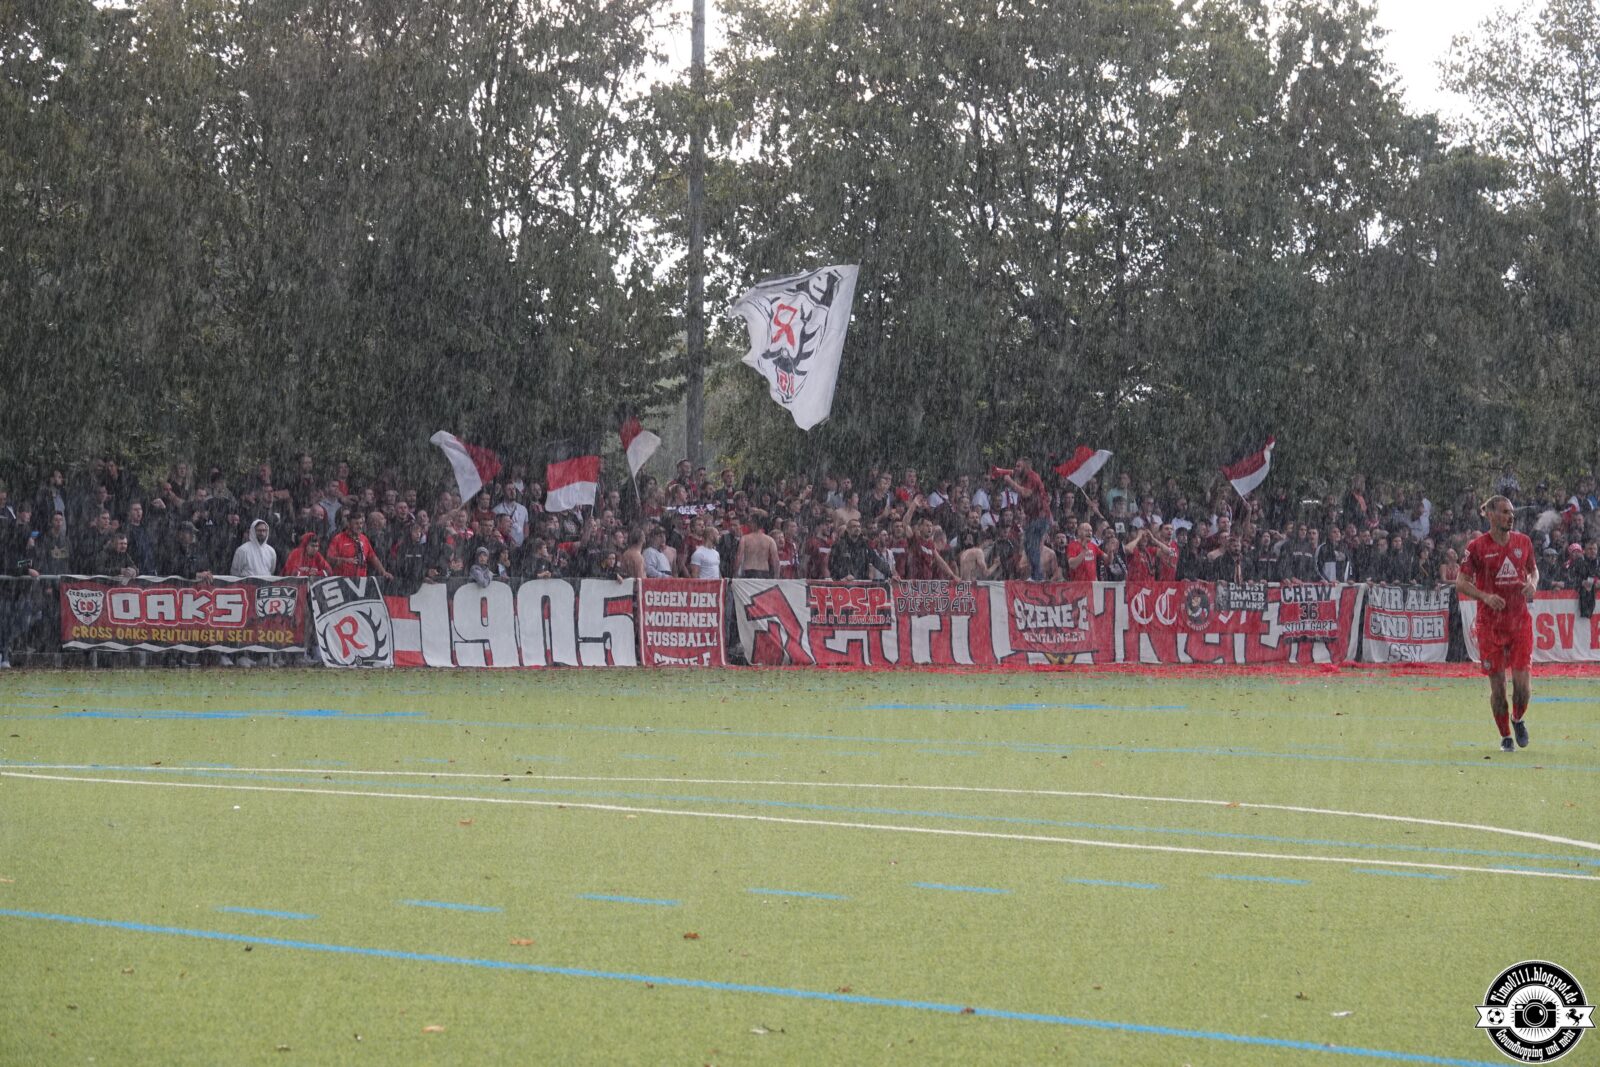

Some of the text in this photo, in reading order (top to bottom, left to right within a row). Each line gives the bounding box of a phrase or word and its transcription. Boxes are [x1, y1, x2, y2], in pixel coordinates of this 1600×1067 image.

[259, 587, 296, 598] SSV
[644, 590, 717, 608] GEGEN DEN
[810, 586, 887, 616] TPSP
[1230, 591, 1265, 602] IMMER
[1282, 584, 1332, 602] CREW
[1368, 586, 1450, 611] WIR ALLE
[108, 590, 247, 624] OAKS
[269, 601, 281, 614] R
[1013, 596, 1089, 630] SZENE E
[1245, 601, 1265, 610] UNS!
[1299, 602, 1319, 621] 36
[409, 578, 637, 667] 1905
[645, 611, 718, 628] MODERNEN
[1370, 612, 1445, 639] SIND DER
[72, 625, 294, 644] CROSS OAKS REUTLINGEN SEIT 2002
[333, 615, 368, 659] R
[646, 631, 718, 647] FUSSBALL!
[1388, 643, 1422, 663] SSV
